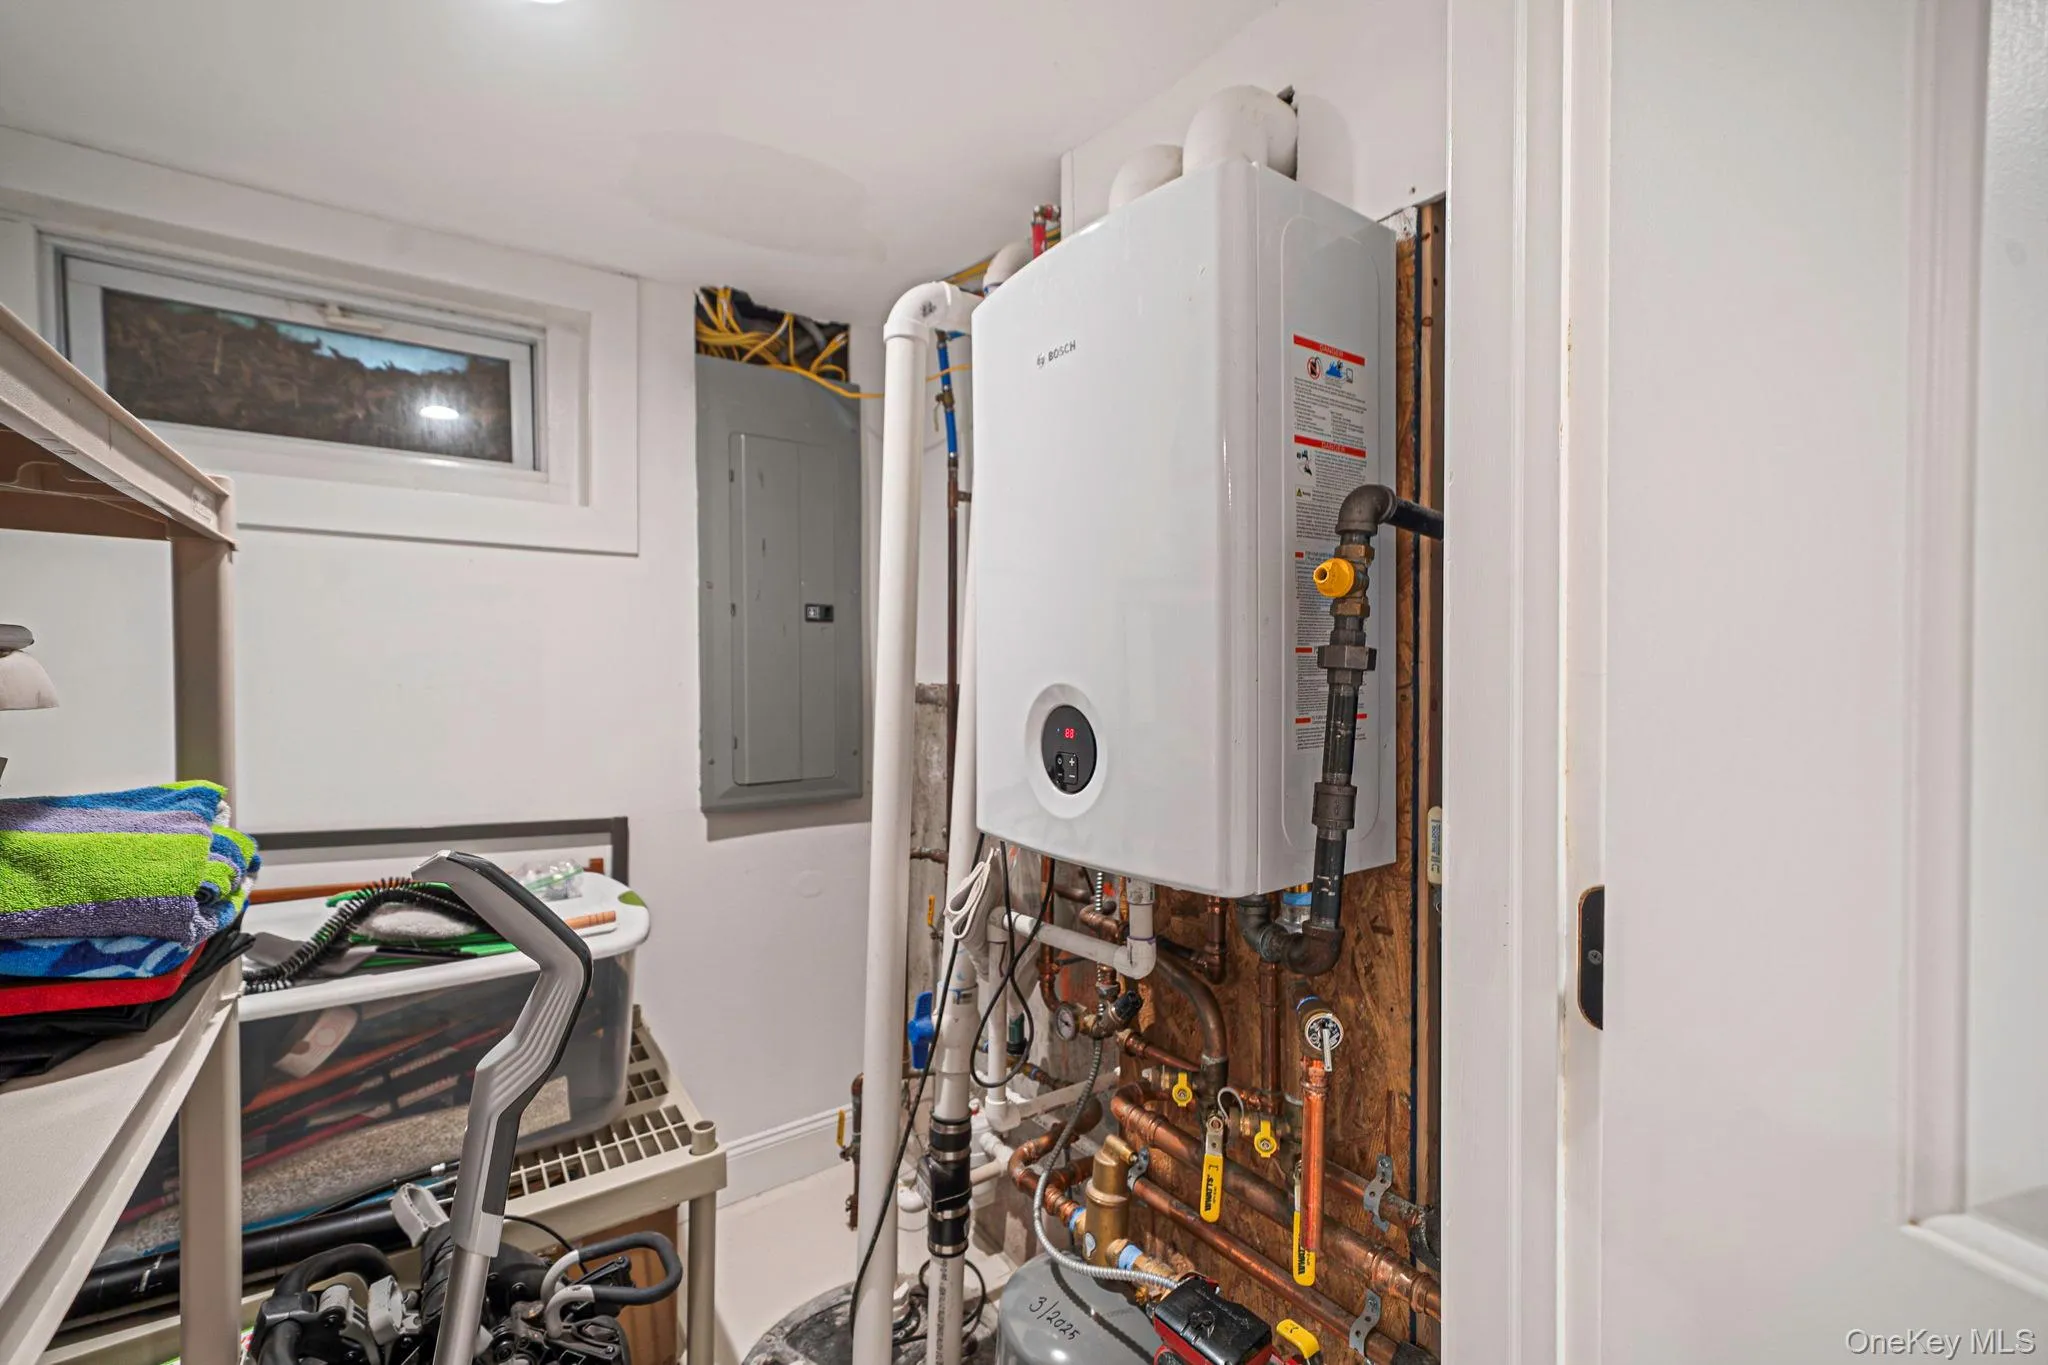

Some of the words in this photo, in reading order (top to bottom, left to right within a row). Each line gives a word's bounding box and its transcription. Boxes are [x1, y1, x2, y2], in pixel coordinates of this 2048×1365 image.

[1048, 339, 1076, 361] BOSCH
[1205, 1174, 1213, 1212] WATTS
[1029, 1296, 1081, 1340] 3/2025
